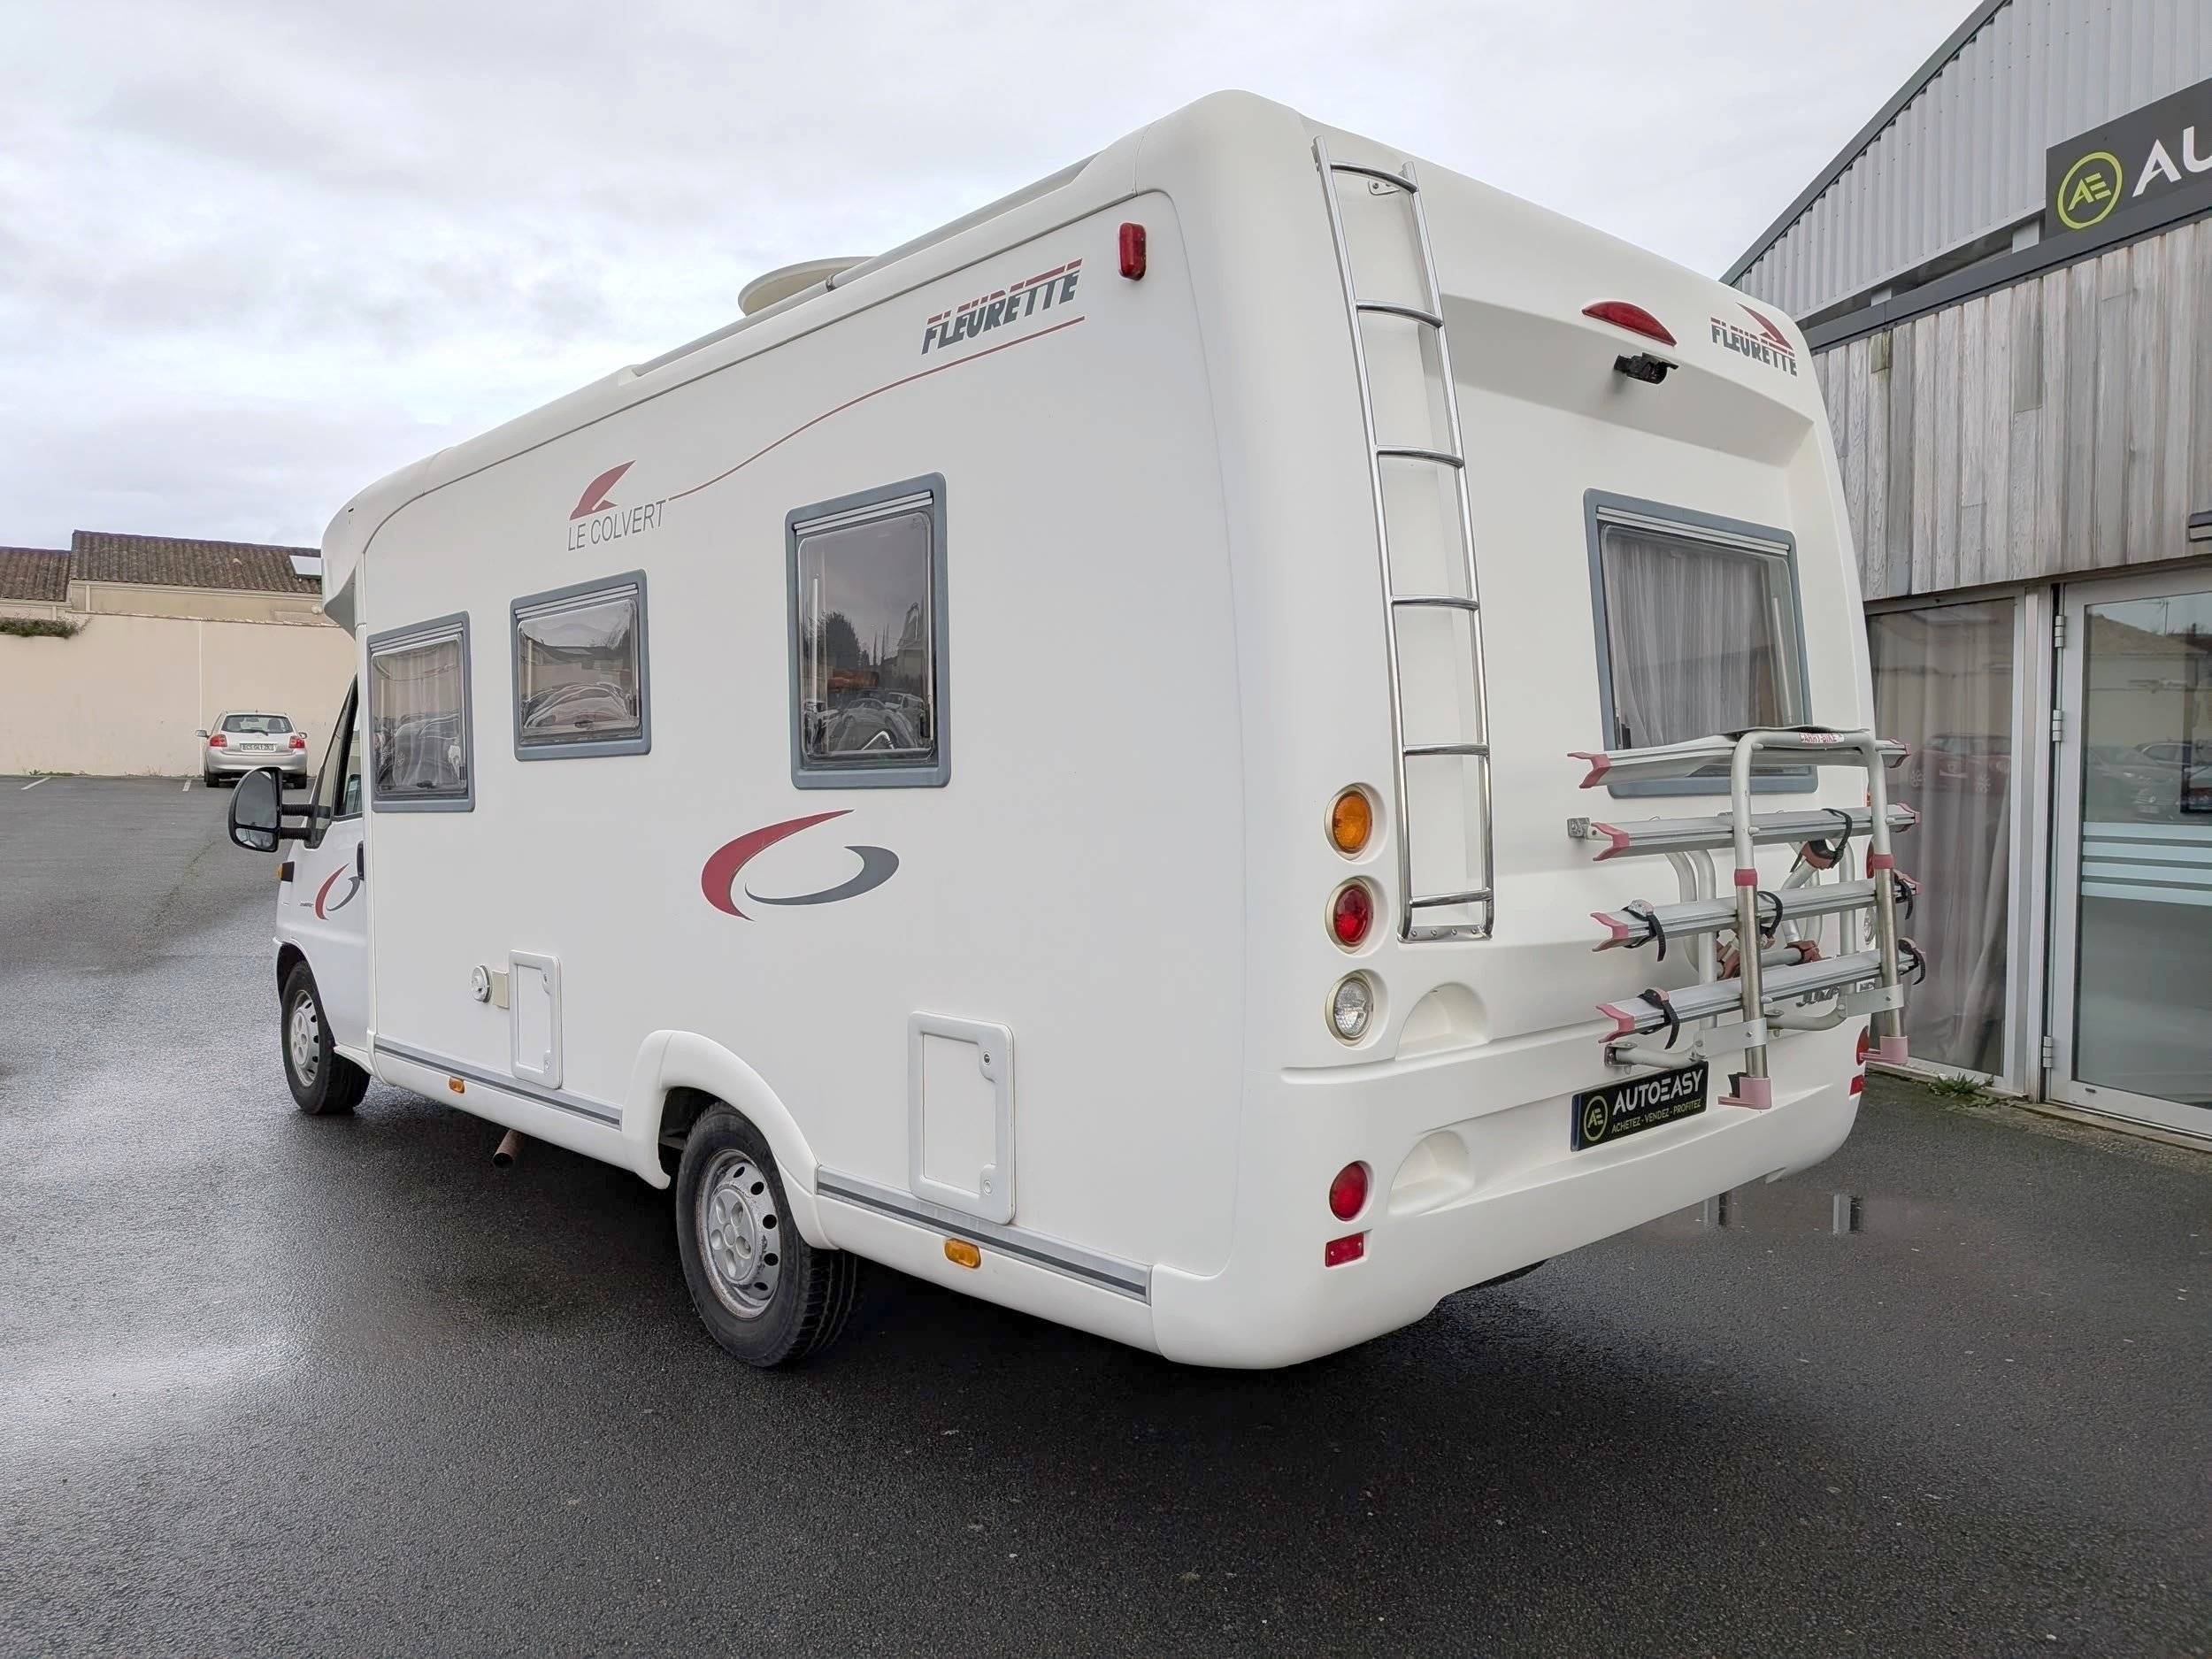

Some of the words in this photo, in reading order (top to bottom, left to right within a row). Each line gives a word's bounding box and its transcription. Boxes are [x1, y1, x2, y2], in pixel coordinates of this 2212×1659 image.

[921, 258, 1083, 356] FLEURETTE
[1710, 317, 1798, 377] FLEURETTE
[567, 523, 587, 551] LE
[590, 500, 666, 545] COLVERT
[1611, 1116, 1641, 1134] ACHETEZ
[1645, 1108, 1670, 1123] VENDEZ
[1672, 1098, 1701, 1115] PROFITEZ
[1612, 1069, 1703, 1116] AUTOEASY
